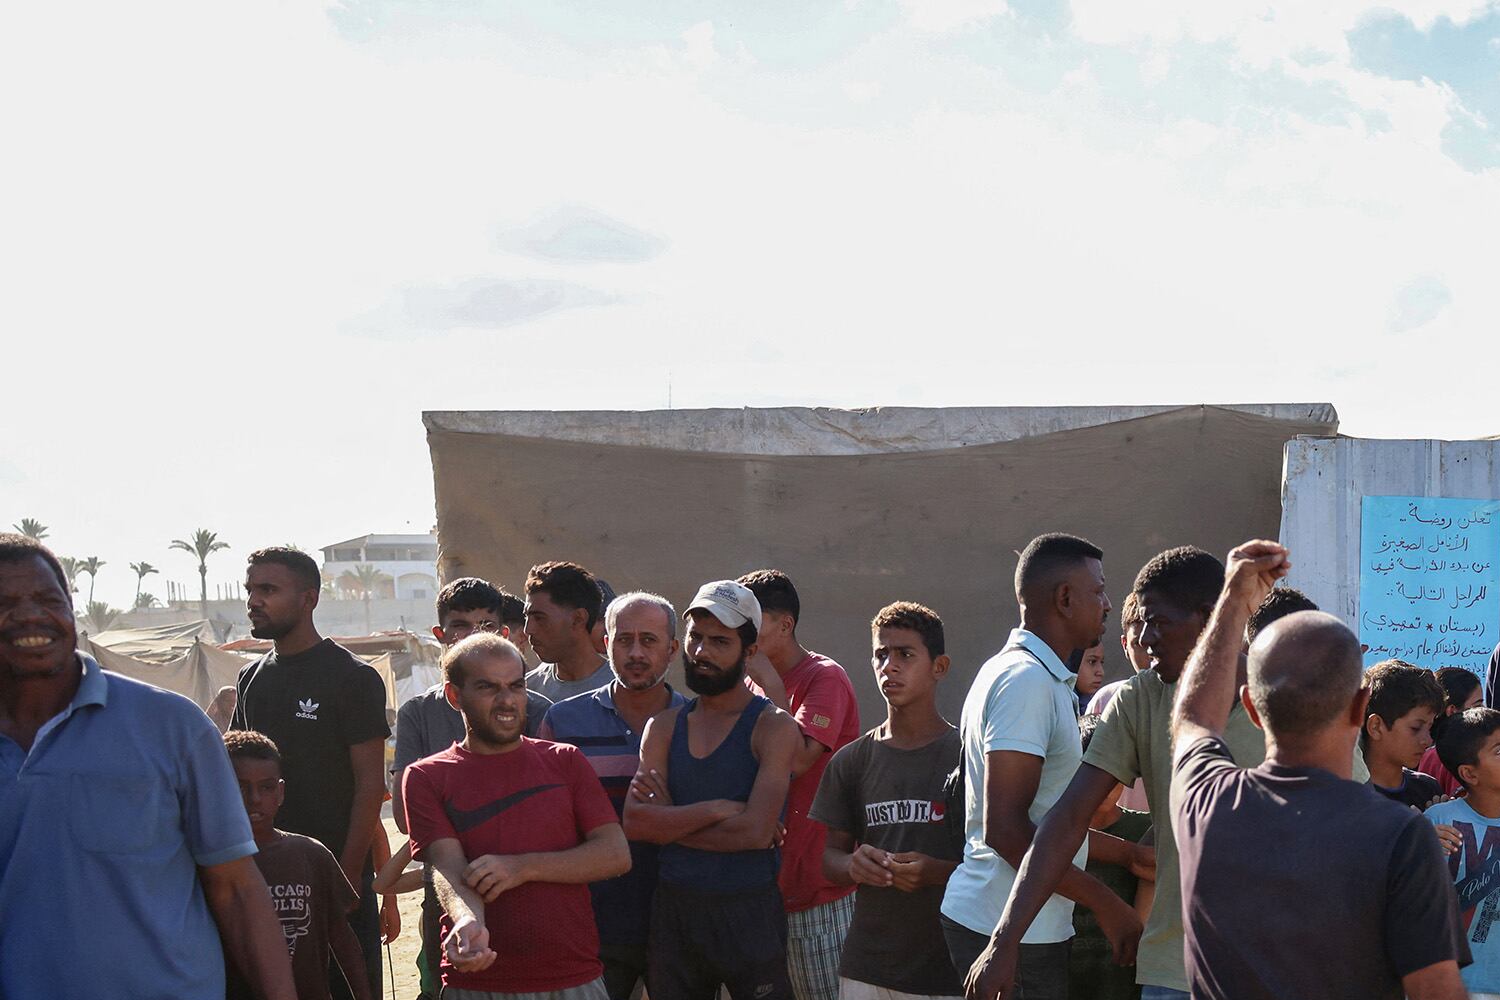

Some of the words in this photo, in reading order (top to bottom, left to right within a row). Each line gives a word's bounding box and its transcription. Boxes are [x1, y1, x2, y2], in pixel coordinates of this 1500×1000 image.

[1408, 503, 1452, 529] روضة
[1458, 512, 1491, 529] تعلن
[1373, 534, 1424, 554] الصغيرة
[1472, 561, 1490, 573] عن
[1396, 582, 1445, 604] التالية
[1449, 584, 1487, 609] للمراحل
[1417, 638, 1431, 659] عام
[295, 712, 318, 720] adidas
[866, 803, 895, 823] JUST
[267, 884, 311, 897] ICAGO
[1461, 873, 1491, 900] Polo
